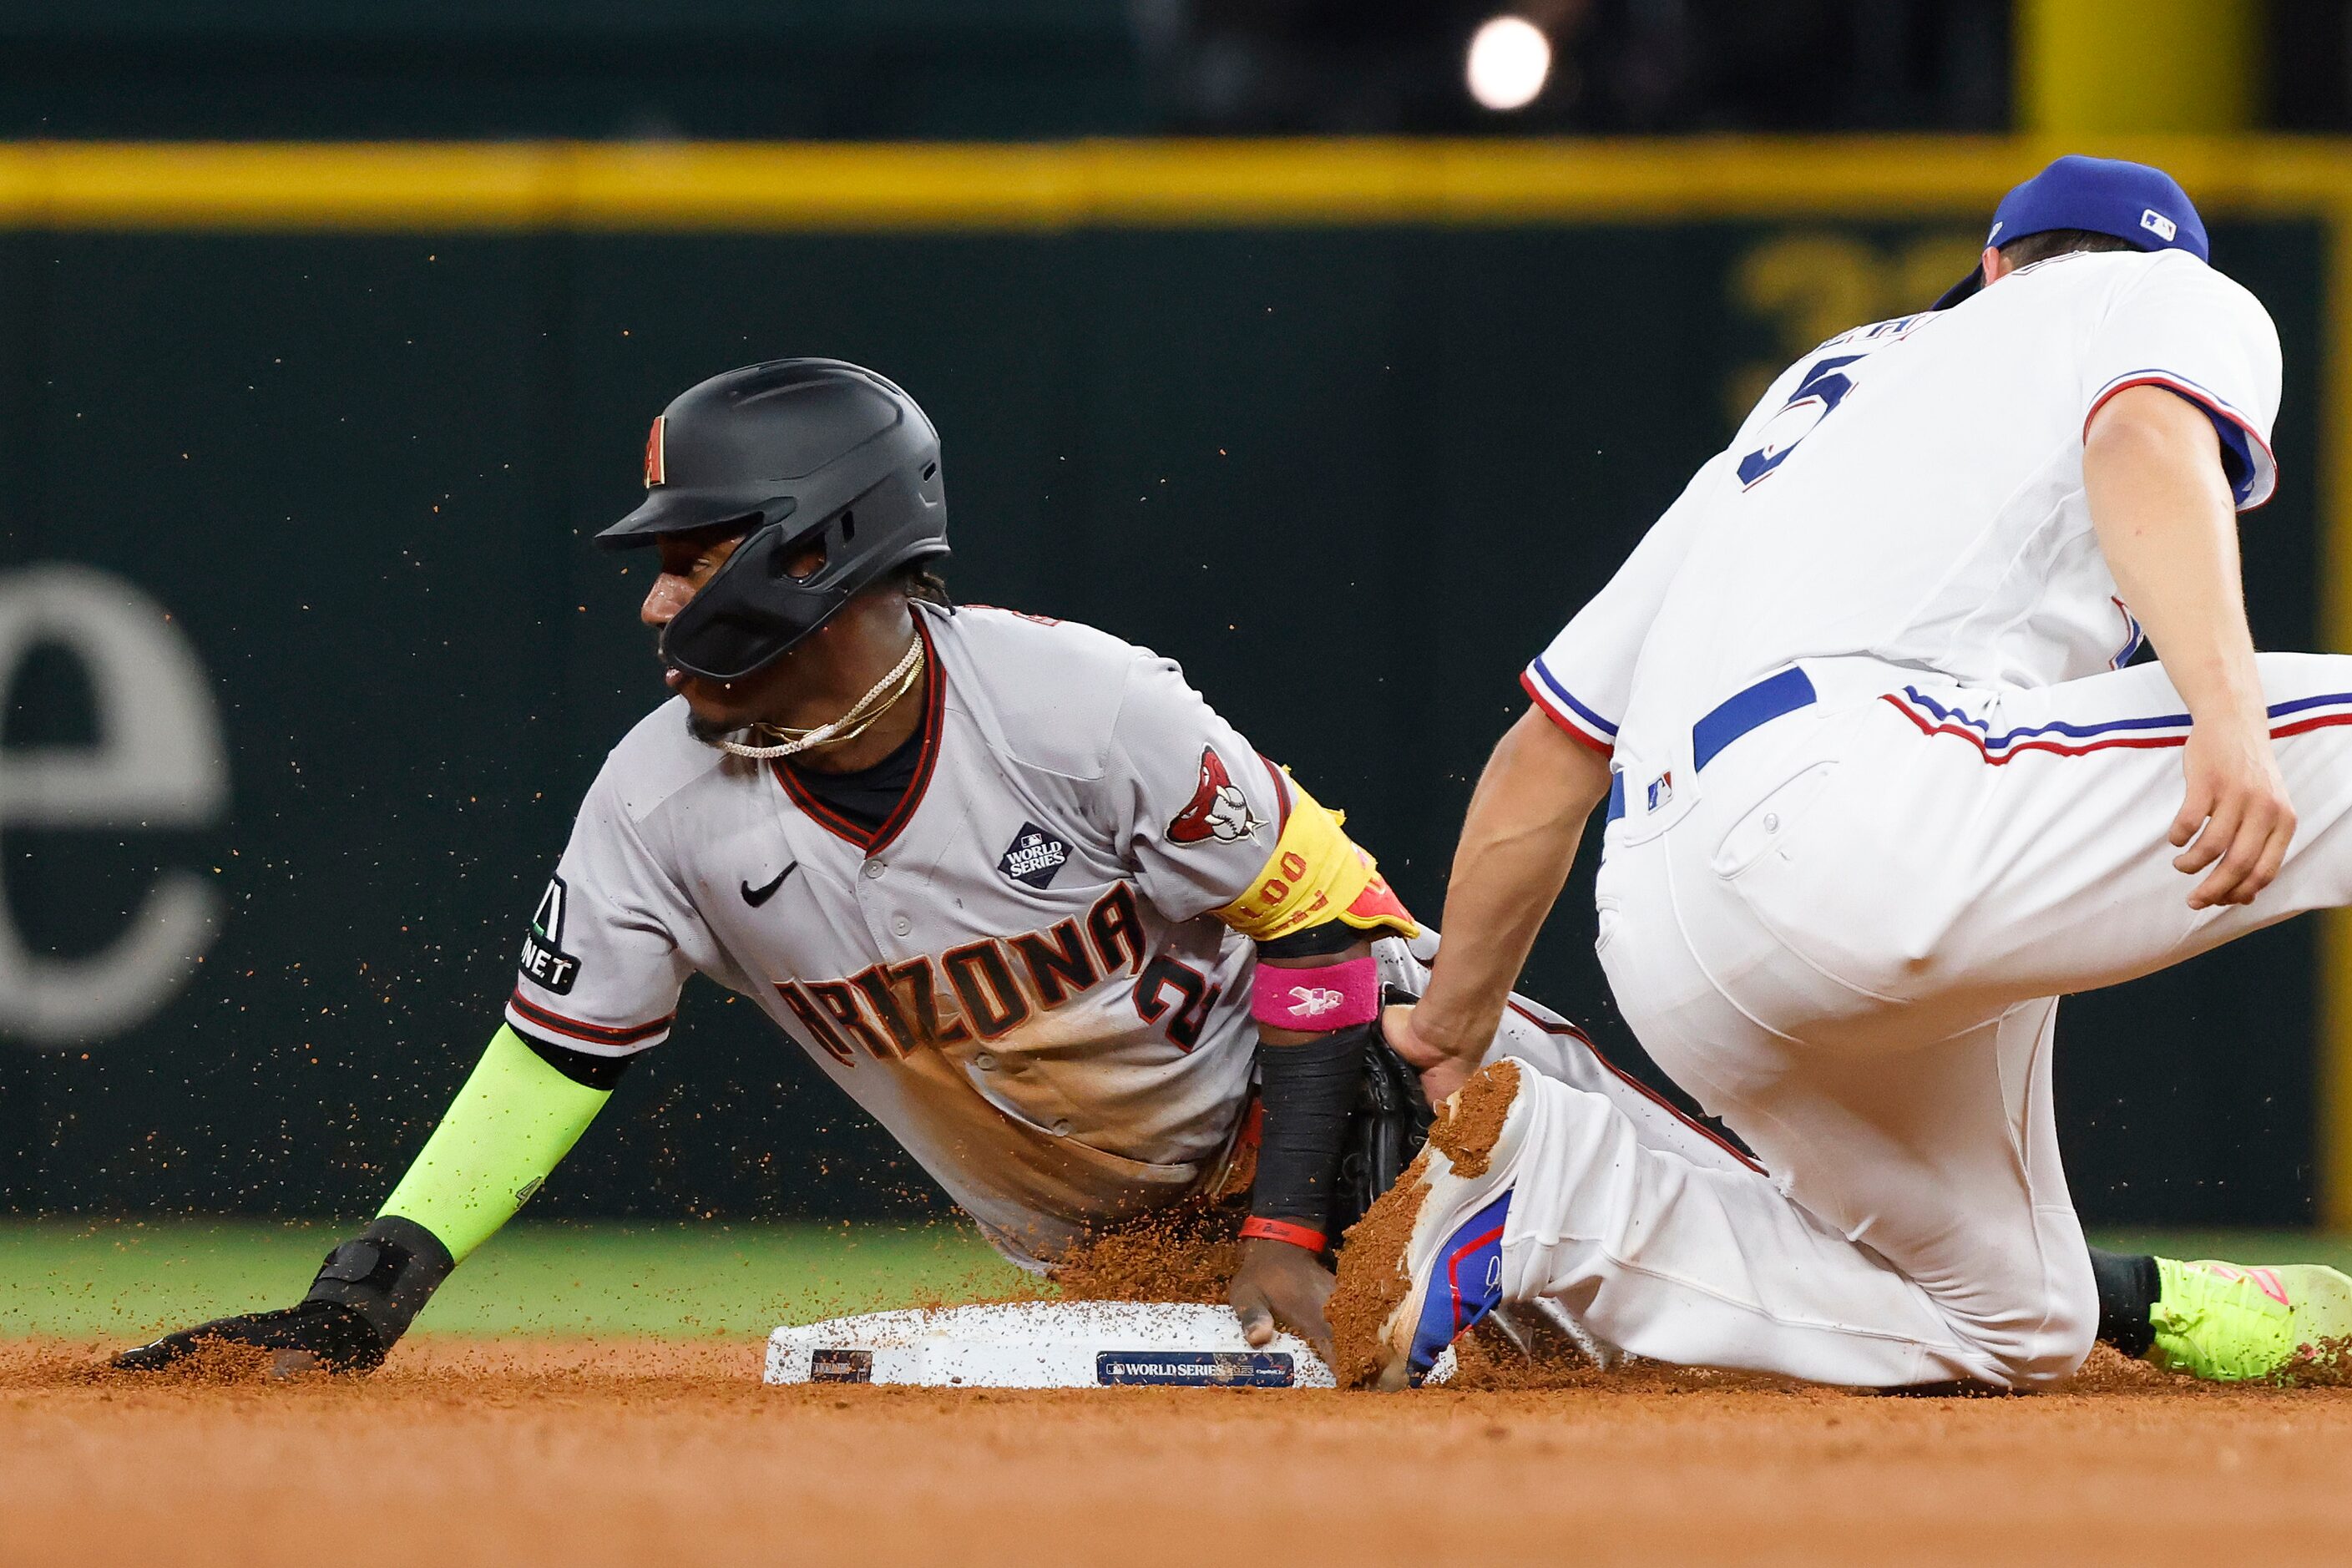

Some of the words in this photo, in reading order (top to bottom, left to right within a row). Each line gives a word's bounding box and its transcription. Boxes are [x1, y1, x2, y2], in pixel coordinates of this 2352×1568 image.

[1736, 352, 1872, 493] 5
[1006, 841, 1062, 865] WORLD
[1010, 852, 1065, 878] SERIES
[521, 936, 573, 984] NET
[771, 879, 1146, 1068] ARIZONA
[1125, 1363, 1176, 1376] WORLD
